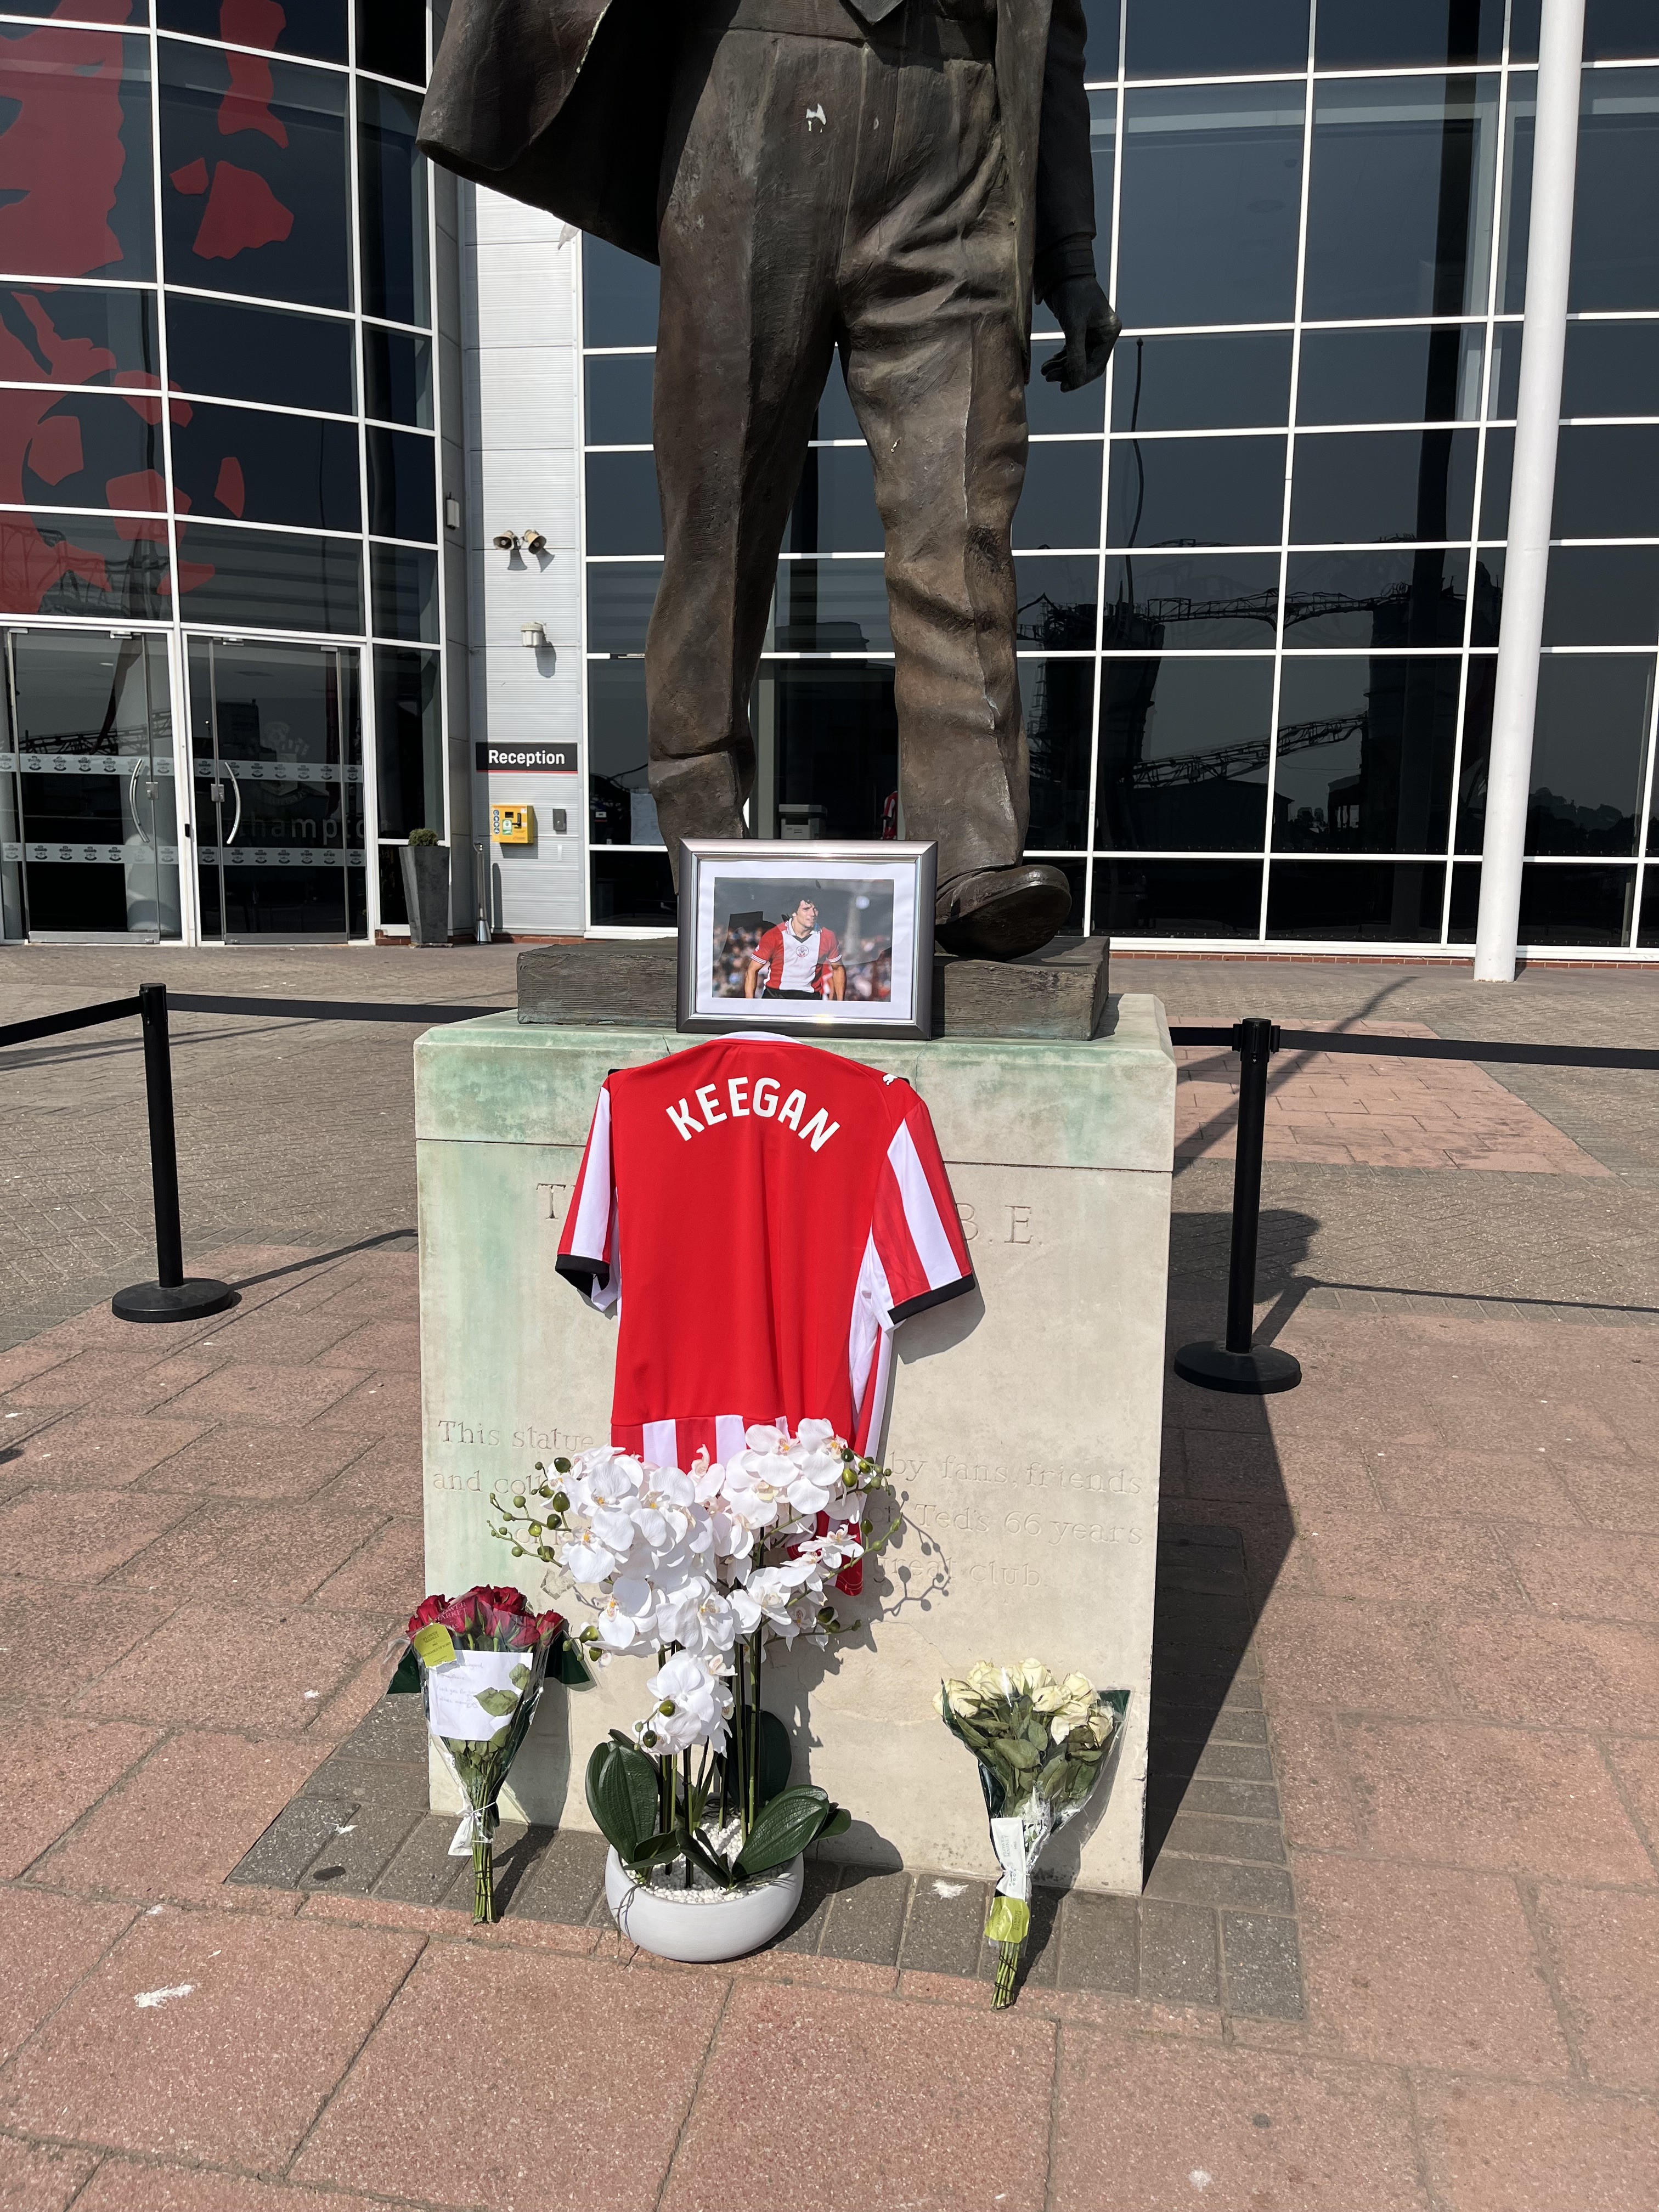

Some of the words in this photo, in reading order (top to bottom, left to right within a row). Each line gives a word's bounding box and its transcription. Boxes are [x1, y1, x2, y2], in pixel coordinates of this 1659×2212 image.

[488, 749, 565, 767] Reception
[665, 1076, 840, 1152] KEEGAN
[438, 1420, 500, 1447] This
[512, 1426, 594, 1452] statue
[433, 1470, 483, 1492] and
[889, 1451, 928, 1482] by
[941, 1455, 1017, 1489] fans,
[1026, 1462, 1143, 1495] friends
[914, 1504, 990, 1532] Ted's
[1004, 1510, 1042, 1537] 66
[1048, 1520, 1143, 1545] years
[873, 1556, 957, 1583] great
[969, 1561, 1042, 1587] club
